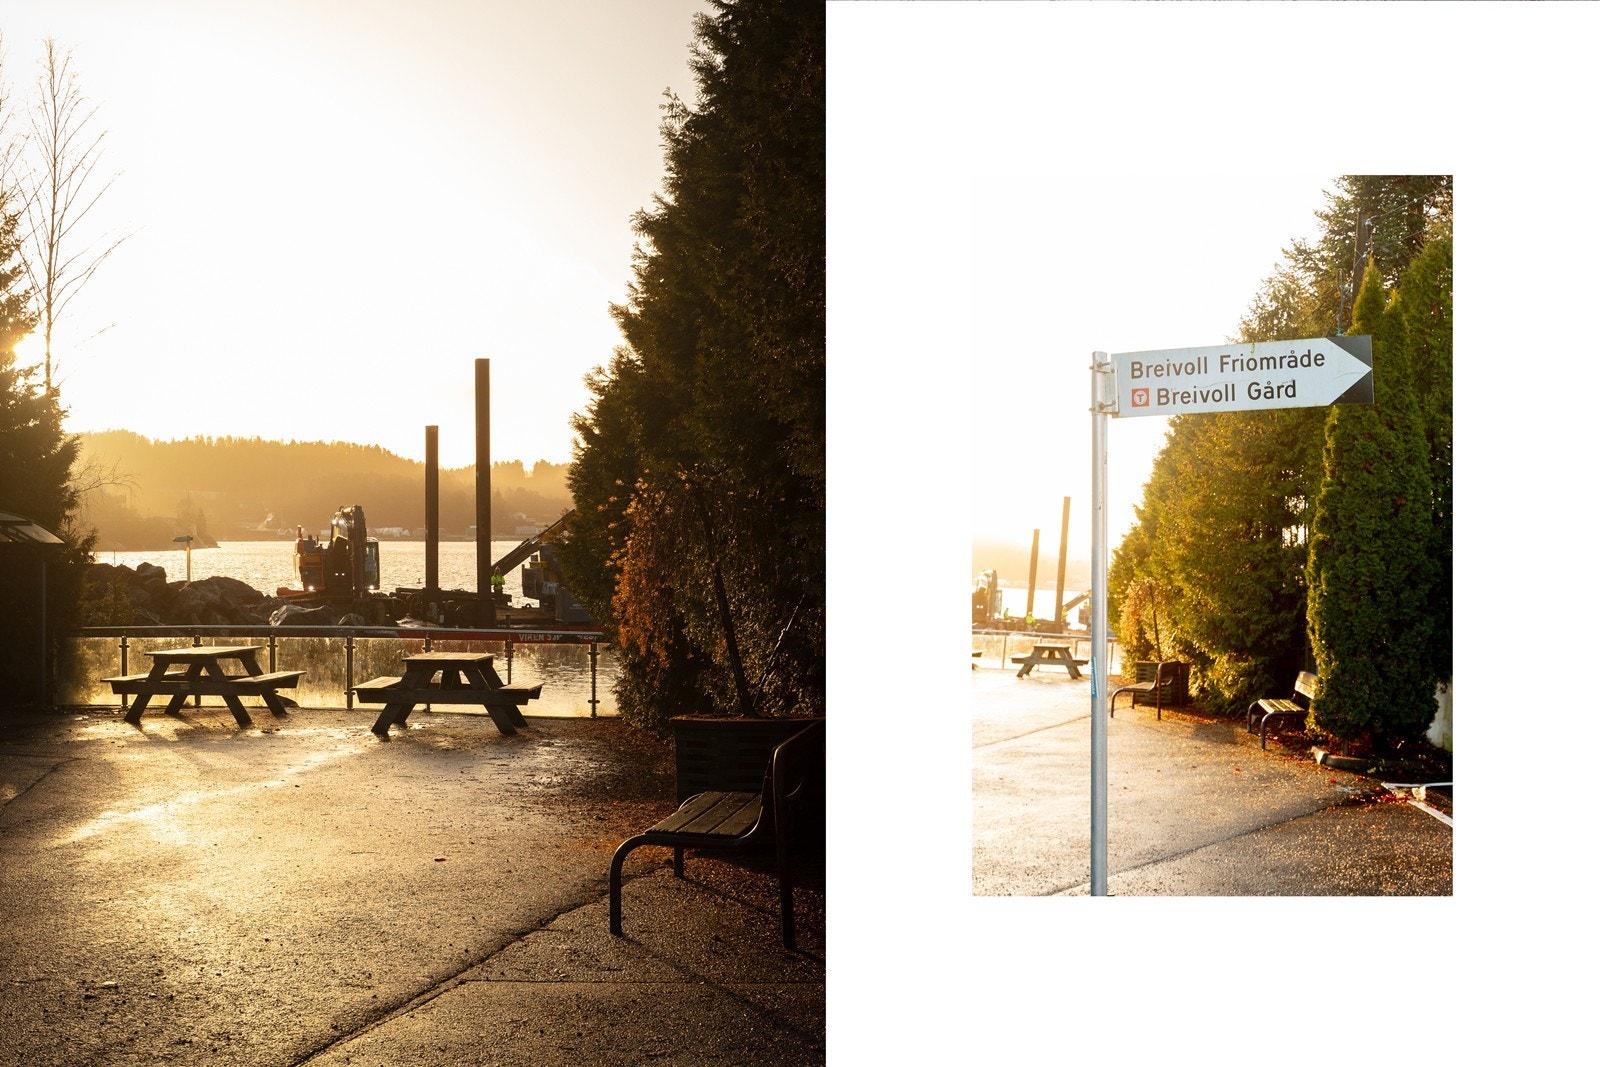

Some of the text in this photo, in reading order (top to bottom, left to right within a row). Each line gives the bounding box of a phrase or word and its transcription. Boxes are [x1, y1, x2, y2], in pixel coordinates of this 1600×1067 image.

[1130, 349, 1325, 379] Breivoll Friområde
[1157, 379, 1297, 406] Breivoll Gård
